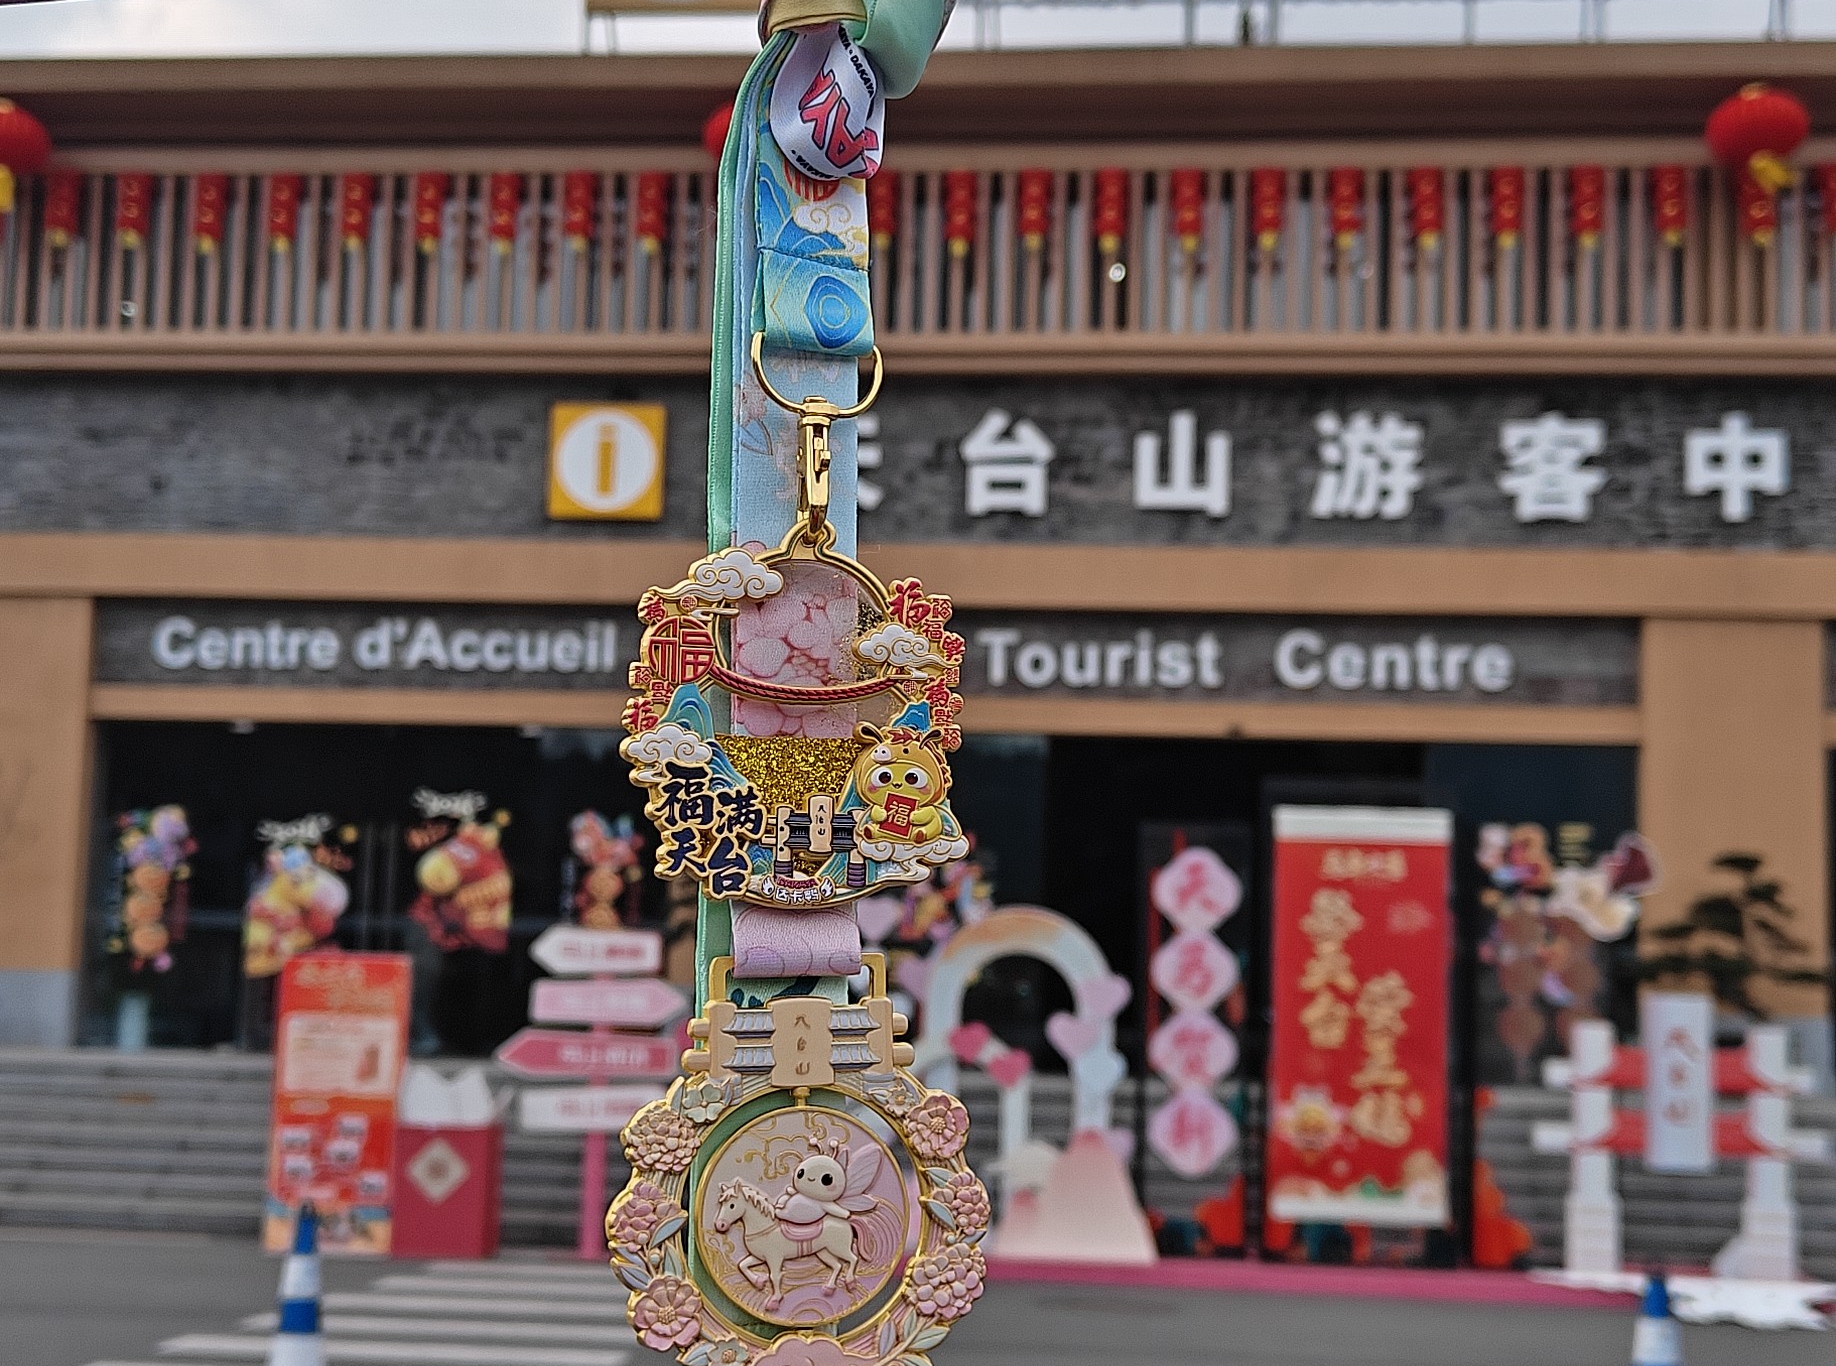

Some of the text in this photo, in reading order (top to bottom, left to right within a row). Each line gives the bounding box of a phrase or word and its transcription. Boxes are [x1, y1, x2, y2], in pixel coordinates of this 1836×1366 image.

[850, 55, 875, 98] DAKAYA
[858, 408, 1791, 524] 台山游客中
[154, 615, 618, 673] Centre d'Accueil
[978, 629, 1223, 688] Tourist
[1273, 627, 1515, 691] Centre
